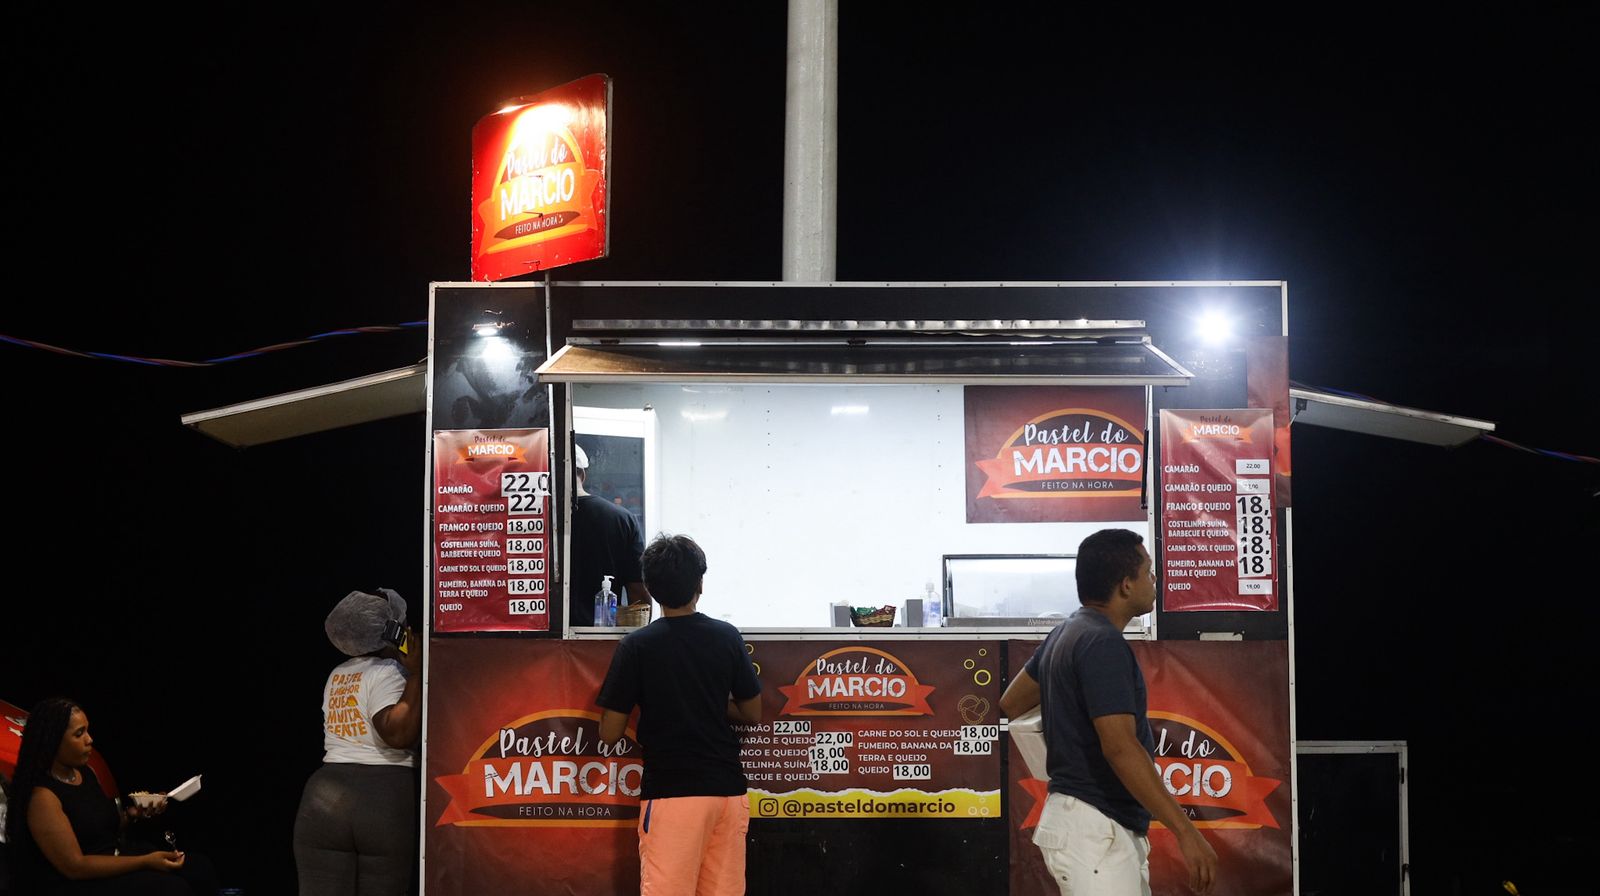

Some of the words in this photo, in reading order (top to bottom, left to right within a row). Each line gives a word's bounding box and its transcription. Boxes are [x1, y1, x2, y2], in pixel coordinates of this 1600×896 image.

[551, 134, 568, 166] do
[501, 167, 575, 222] MARCIO
[515, 222, 532, 235] FEITO
[532, 219, 541, 230] NA
[1024, 421, 1095, 446] Pastel
[1100, 422, 1128, 445] do
[1193, 424, 1240, 436] MARCIO
[467, 444, 515, 457] MARCIO
[1012, 446, 1142, 477] MARCIO
[1164, 464, 1200, 473] CAMARÃO
[438, 484, 473, 494] CAMARÃO
[1041, 481, 1069, 490] FEITO
[1072, 481, 1085, 489] NA
[1087, 480, 1114, 490] HORA
[1164, 482, 1200, 492] CAMARÃO
[1201, 483, 1206, 491] E
[1206, 483, 1232, 493] QUEIJO
[438, 502, 472, 513] CAMARÃO
[479, 503, 505, 513] QUEIJO
[510, 494, 542, 514] 22,
[1166, 502, 1197, 511] FRANGO
[1204, 502, 1231, 512] QUEIJO
[439, 523, 470, 532] FRANGO
[471, 523, 476, 531] E
[476, 522, 504, 533] QUEIJO
[508, 520, 543, 533] 18,00
[1168, 520, 1206, 528] COSTELINHA
[1168, 530, 1201, 538] BARBECUE
[1206, 530, 1229, 538] QUEIJO
[440, 541, 478, 549] COSTELINHA
[507, 540, 543, 552] 18,00
[1167, 544, 1187, 552] CARNE
[1187, 544, 1196, 552] DO
[1197, 544, 1208, 552] SOL
[1213, 544, 1235, 553] QUEIJO
[440, 550, 473, 558] BARBECUE
[478, 551, 501, 559] QUEIJO
[439, 565, 460, 573] CARNE
[485, 565, 507, 573] QUEIJO
[508, 560, 544, 573] 18,00
[1167, 560, 1197, 568] FUMEIRO,
[1225, 559, 1235, 567] DA
[1168, 569, 1188, 577] TERRA
[1188, 569, 1193, 577] E
[1193, 569, 1217, 578] QUEIJO
[470, 580, 497, 588] BANANA
[509, 580, 544, 593] 18,00
[1168, 582, 1191, 592] QUEIJO
[439, 590, 460, 598] TERRA
[460, 590, 465, 598] E
[465, 590, 488, 599] QUEIJO
[439, 603, 463, 612] QUEIJO
[510, 600, 545, 613] 18,00
[816, 656, 870, 676] Pastel
[875, 656, 897, 675] do
[807, 676, 906, 699] MARCIO
[828, 702, 850, 710] FEITO
[852, 702, 863, 710] NA
[863, 702, 885, 710] HORA
[326, 707, 363, 724] MUITA
[326, 721, 368, 737] GENTE
[774, 721, 811, 734] 22,00
[962, 726, 998, 739] 18,00
[816, 733, 853, 745] 22,00
[858, 730, 887, 738] CARNE
[889, 730, 903, 738] DO
[904, 730, 921, 738] SOL
[930, 730, 961, 738] QUEIJO
[501, 726, 588, 759] Pastel
[781, 737, 816, 745] QUEIJO
[858, 742, 899, 750] FUMEIRO,
[901, 742, 938, 750] BANANA
[939, 742, 953, 750] DA
[1181, 730, 1216, 759] do
[764, 749, 770, 757] E
[772, 749, 808, 757] QUEIJO
[955, 741, 991, 754] 18,00
[809, 747, 845, 760] 18,00
[858, 754, 886, 762] TERRA
[887, 754, 893, 762] E
[895, 754, 927, 763] QUEIJO
[813, 760, 848, 772] 18,00
[857, 766, 890, 775] QUEIJO
[894, 765, 930, 778] 18,00
[483, 760, 645, 798] MARCIO
[776, 773, 782, 781] E
[784, 773, 820, 781] QUEIJO
[519, 806, 554, 816] FEITO
[558, 806, 574, 816] NA
[578, 806, 611, 816] HORA
[783, 798, 956, 817] @pasteldomarcio
